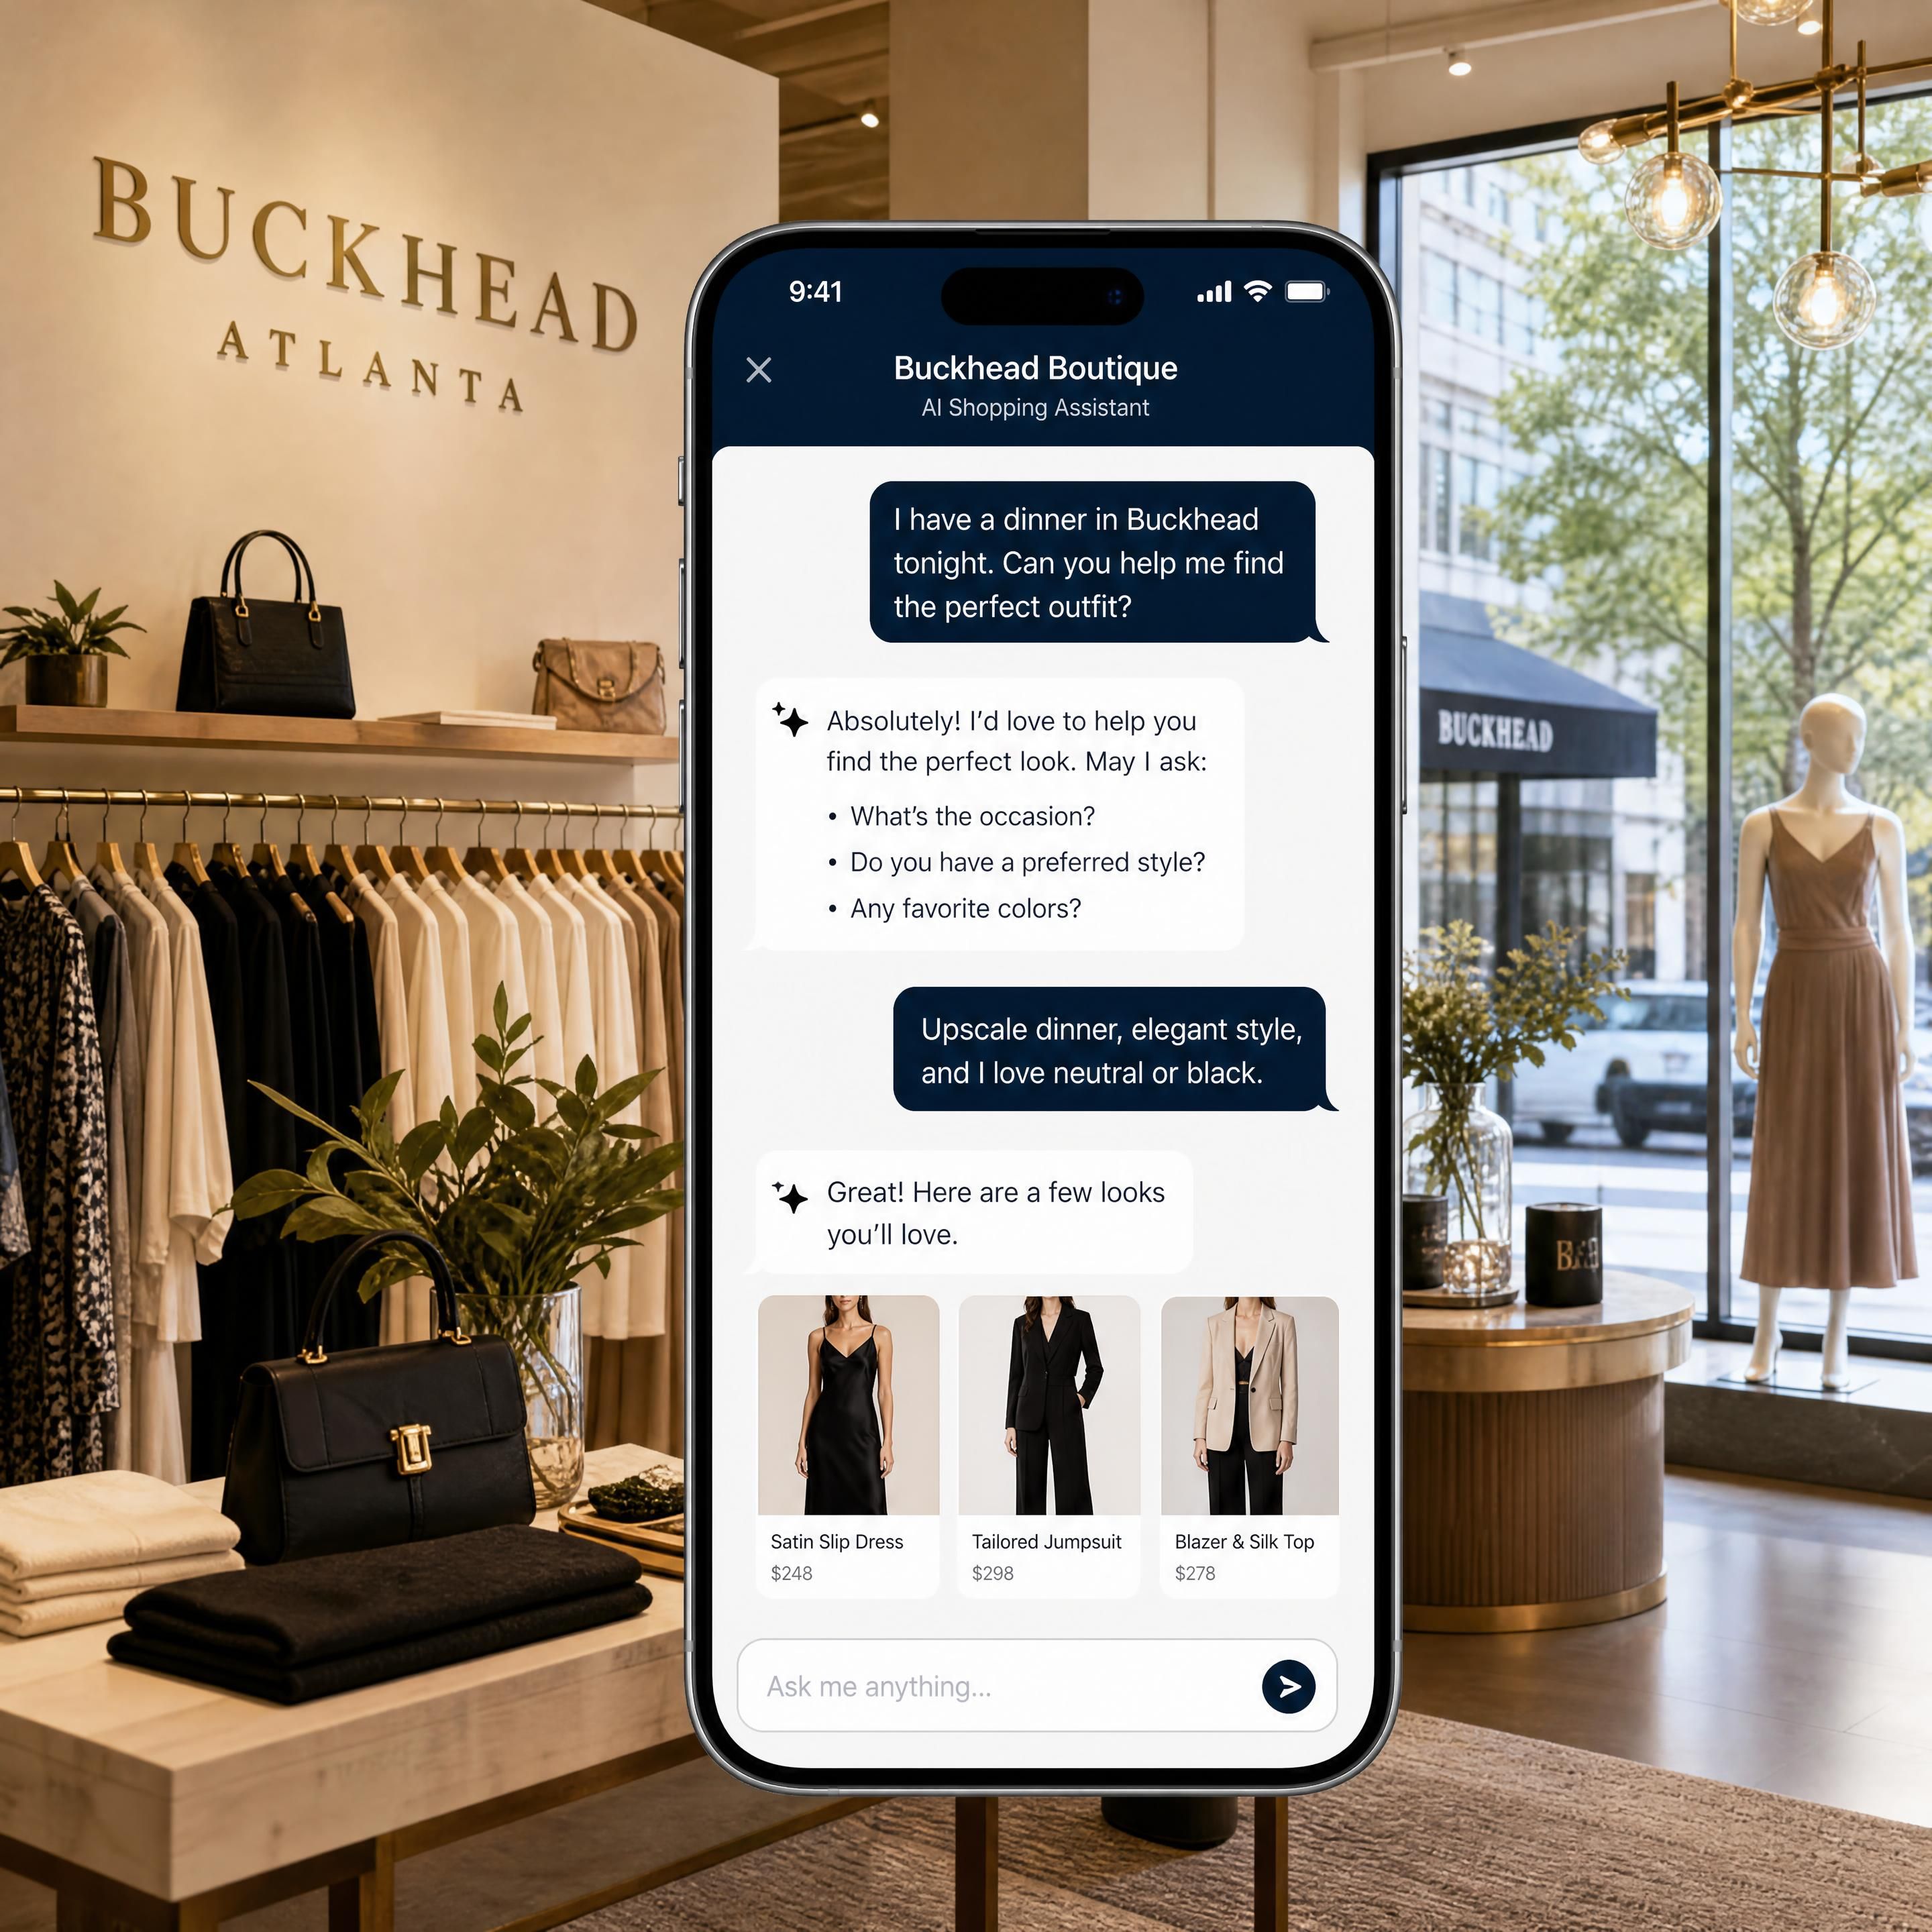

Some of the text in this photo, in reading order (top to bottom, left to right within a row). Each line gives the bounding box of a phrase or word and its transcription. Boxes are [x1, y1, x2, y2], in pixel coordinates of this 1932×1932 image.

[93, 154, 639, 353] BUCKHEAD
[789, 280, 841, 303] 9:41
[216, 319, 525, 413] ATLANTA
[895, 354, 1178, 386] Buckhead Boutique
[921, 397, 1150, 421] AI Shopping Assistant
[896, 506, 1258, 531] I have a dinner in Buckhead
[894, 550, 1283, 580] tonight. Can you help me find
[894, 594, 1132, 624] the perfect outfit?
[826, 710, 1196, 737] Absolutely! I’d love to help you
[1438, 708, 1554, 753] BUCKHEAD
[826, 750, 1206, 777] find the perfect look. May I ask:
[851, 805, 1095, 826] What’s the occasion?
[851, 851, 1205, 877] Do you have a preferred style?
[850, 897, 1081, 924] Any favorite colors?
[922, 1016, 1302, 1046] Upscale dinner, elegant style,
[922, 1061, 1263, 1084] and I love neutral or black.
[828, 1180, 1165, 1203] Great! Here are a few looks
[827, 1222, 957, 1250] you’ll love.
[771, 1534, 904, 1553] Satin Slip Dress
[971, 1534, 1122, 1553] Tailored Jumpsuit
[1175, 1534, 1315, 1553] Blazer & Silk Top
[771, 1564, 813, 1582] $248
[972, 1564, 1014, 1582] $298
[1175, 1564, 1216, 1582] $278
[767, 1674, 991, 1703] Ask me anything...
